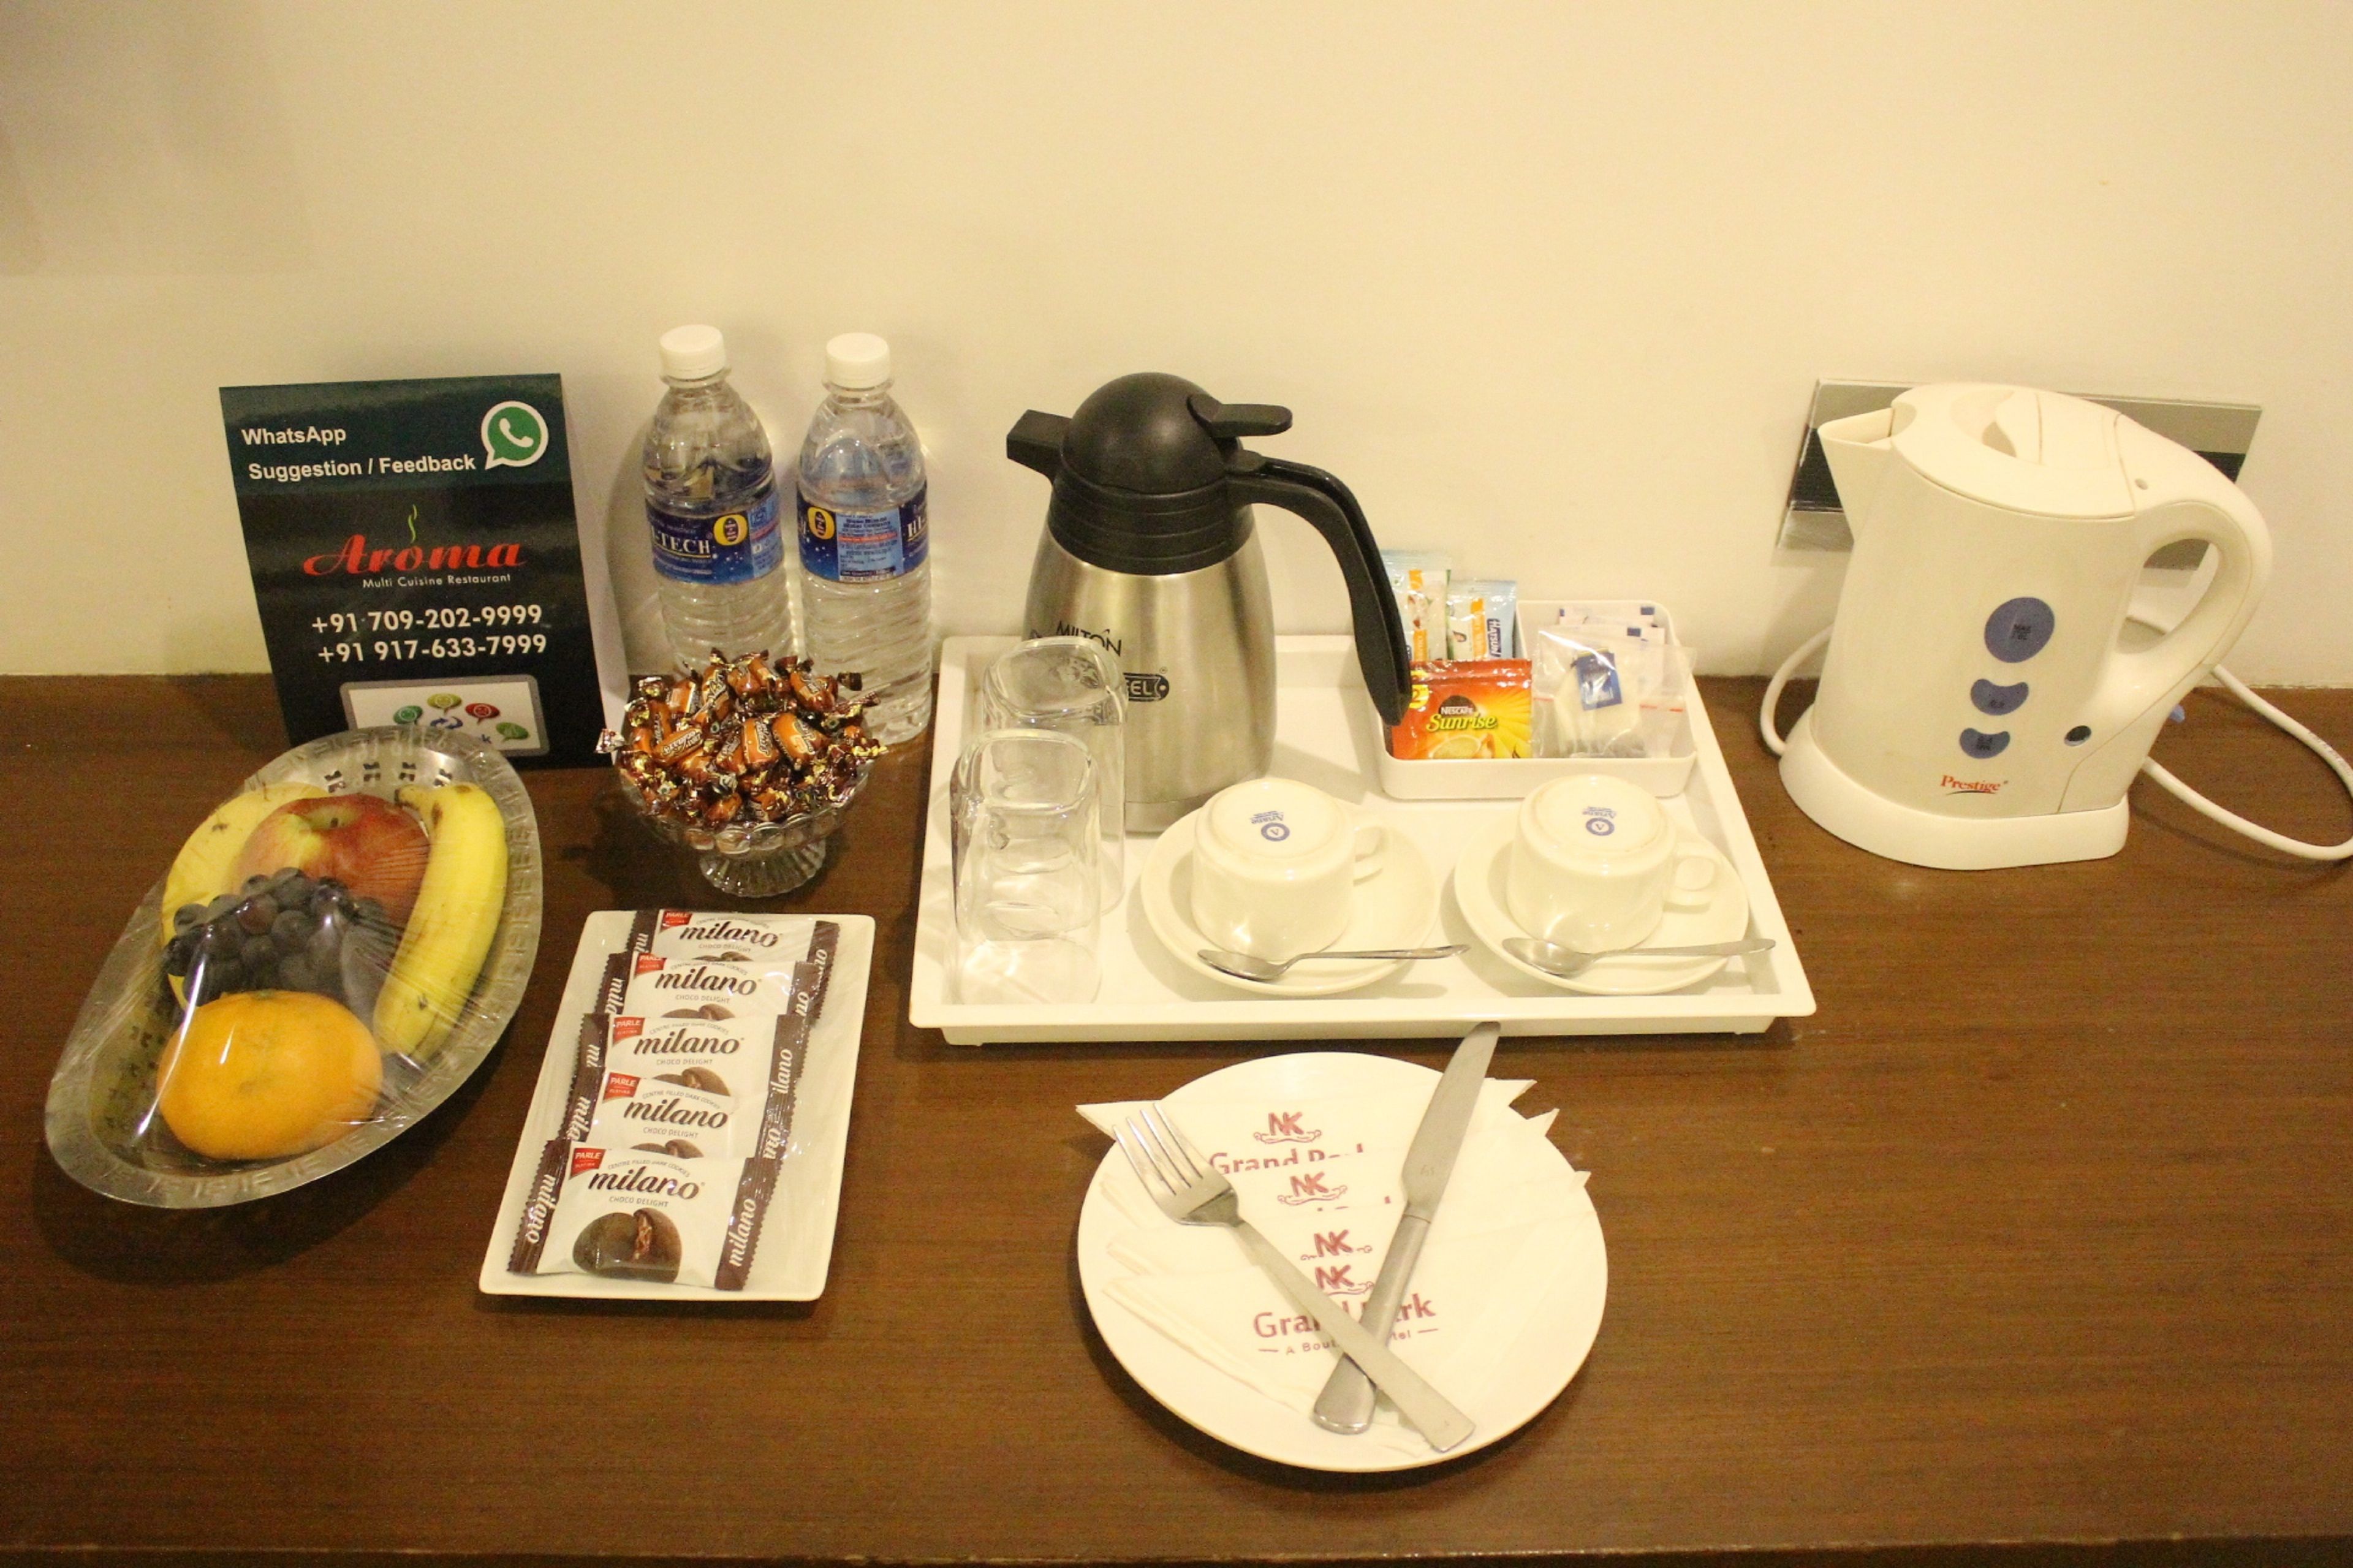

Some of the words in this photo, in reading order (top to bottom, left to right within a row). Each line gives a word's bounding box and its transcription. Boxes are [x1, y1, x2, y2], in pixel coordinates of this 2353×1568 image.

[243, 426, 346, 446] WhatsApp
[249, 457, 362, 482] Suggestion
[368, 457, 374, 475] /
[379, 454, 476, 473] Feedback
[652, 525, 711, 554] I-TECH
[302, 534, 526, 577] Aroma
[363, 578, 393, 588] Multi
[398, 575, 443, 587] Cuisine
[448, 574, 511, 586] Restaurant
[312, 613, 358, 634] +91
[370, 604, 542, 631] 709-202-9999
[317, 643, 365, 663] +91
[374, 634, 547, 661] 917-633-7999
[1487, 619, 1502, 656] HATSUN
[1425, 711, 1498, 732] Sunrise
[1941, 775, 2001, 793] Prestige
[680, 921, 778, 947] milano
[655, 966, 757, 996] milano
[701, 995, 731, 1004] DELIGHT
[633, 1028, 740, 1055] milano
[611, 1077, 637, 1086] PARLE
[771, 1048, 794, 1096] ilano
[623, 1098, 729, 1129] milano
[1268, 1112, 1304, 1135] NK
[643, 1126, 667, 1135] CHOCO
[669, 1129, 699, 1138] DELIGHT
[588, 1165, 699, 1200] milano
[1289, 1171, 1329, 1196] NK
[608, 1195, 634, 1204] CHOCO
[636, 1197, 669, 1208] DELIGHT
[729, 1198, 757, 1267] milano
[1313, 1229, 1354, 1257] NK
[1315, 1265, 1355, 1290] NK
[1391, 1329, 1412, 1341] tel
